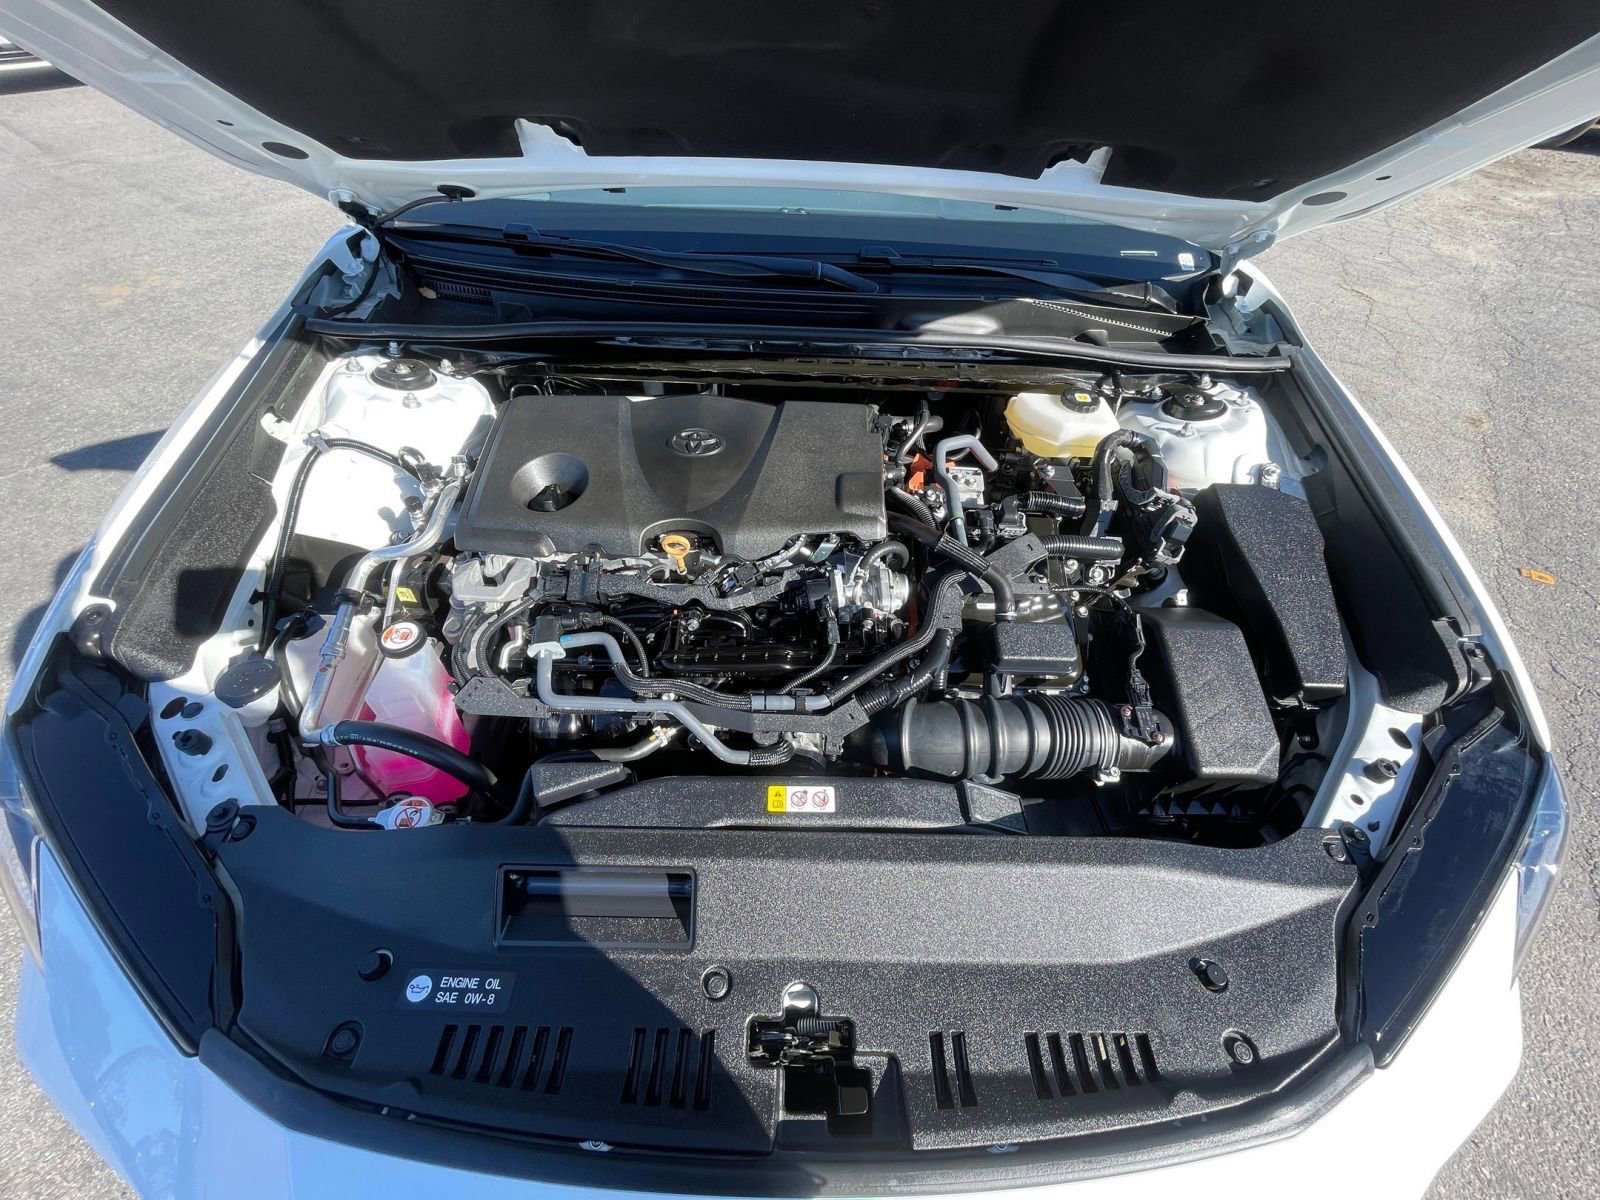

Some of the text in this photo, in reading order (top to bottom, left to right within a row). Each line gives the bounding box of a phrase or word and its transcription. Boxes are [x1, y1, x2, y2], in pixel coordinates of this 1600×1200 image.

[440, 976, 502, 990] ENGINE OIL
[435, 991, 496, 1005] SAE 0W-8
